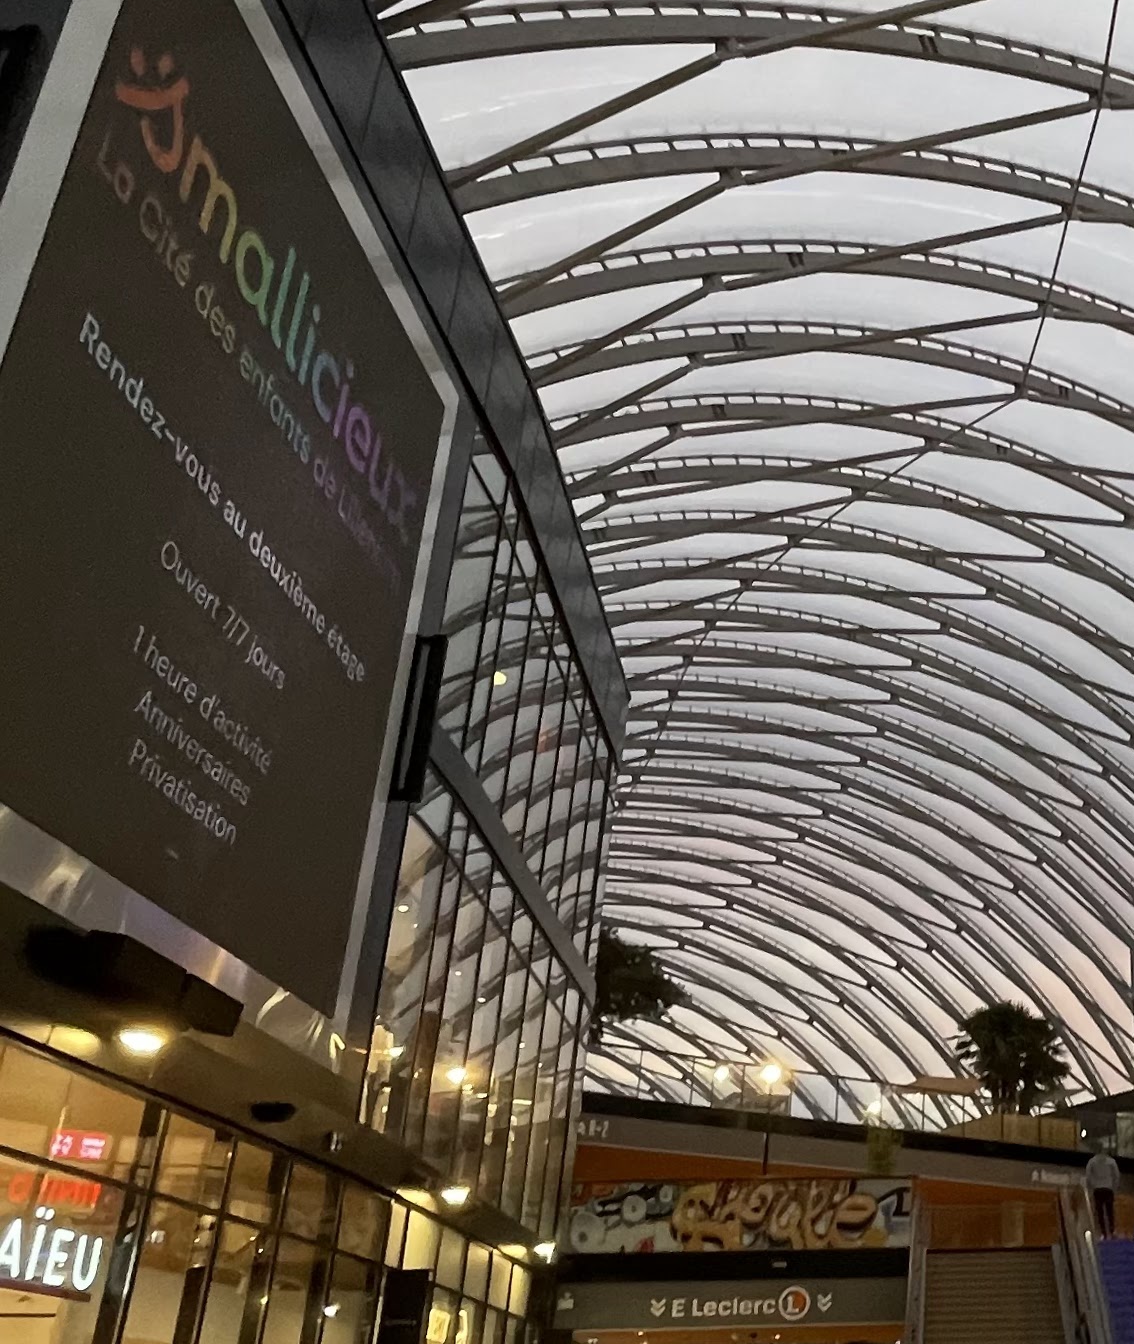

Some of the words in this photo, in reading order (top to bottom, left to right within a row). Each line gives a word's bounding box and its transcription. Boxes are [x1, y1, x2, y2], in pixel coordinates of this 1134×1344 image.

[195, 283, 236, 354] des
[239, 349, 310, 464] enfants
[79, 311, 220, 506] Rendez-vous
[223, 500, 249, 539] au
[249, 528, 326, 636] deuxième
[327, 622, 365, 682] étage
[160, 541, 221, 620] Ouvert
[222, 605, 250, 647] 7/7
[244, 634, 286, 690] jours
[133, 624, 145, 654] 1
[144, 635, 198, 704] heure
[200, 693, 272, 775] d'activité
[133, 689, 251, 806] Anniversaires
[128, 737, 238, 845] Privatisation
[671, 1298, 686, 1318] E
[692, 1296, 776, 1318] Leclerc
